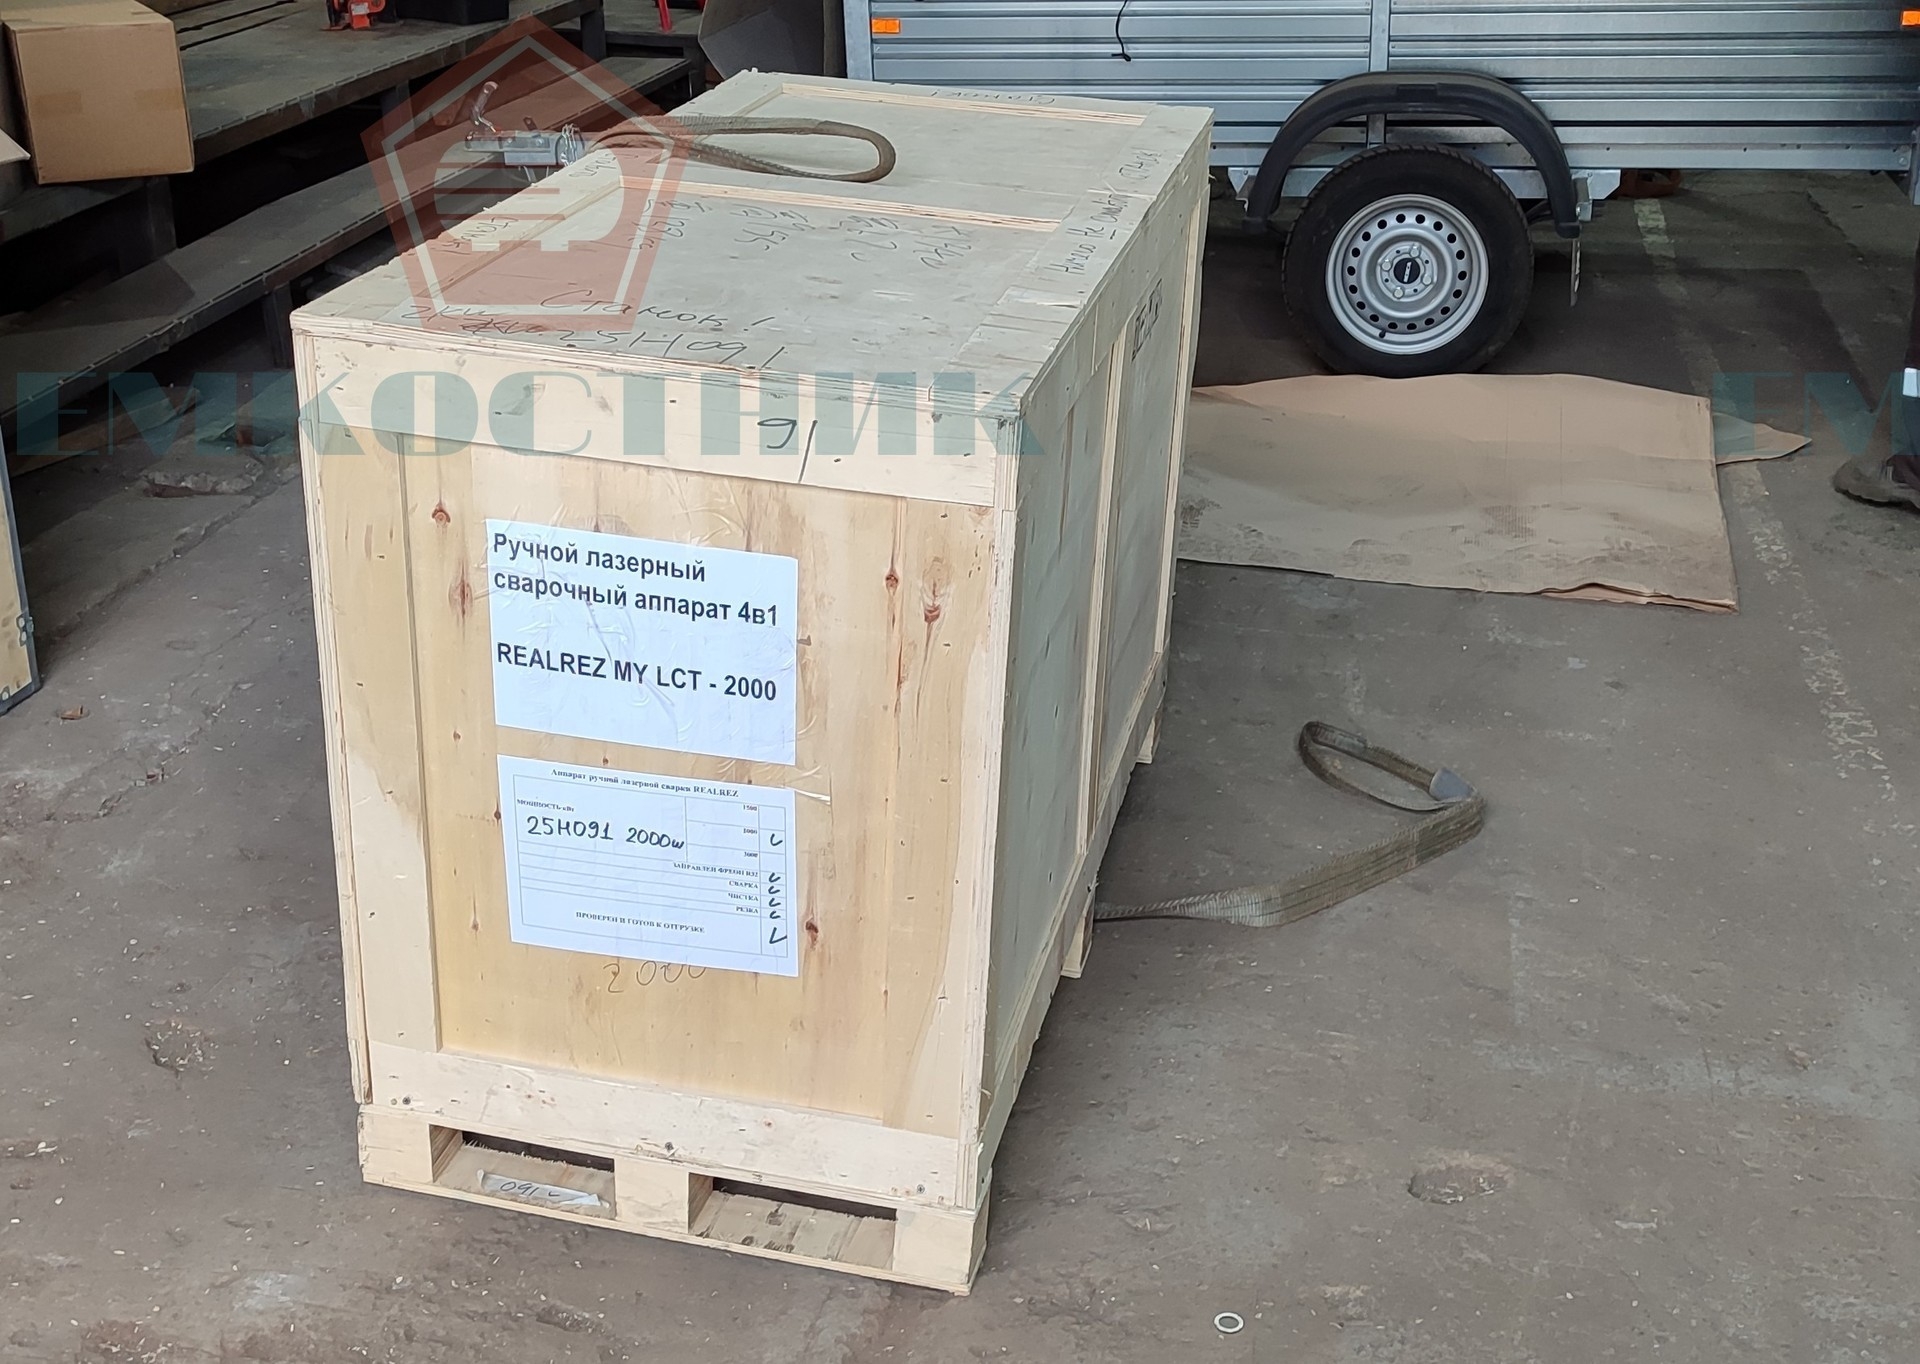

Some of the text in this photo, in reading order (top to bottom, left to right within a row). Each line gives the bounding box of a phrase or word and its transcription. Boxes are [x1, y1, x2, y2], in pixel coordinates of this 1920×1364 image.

[494, 533, 705, 582] Ручной лазерный
[494, 572, 777, 626] сварочный аппарат 4в1
[497, 642, 606, 679] REALREZ
[614, 660, 648, 684] MY
[657, 666, 702, 691] LCT
[724, 675, 777, 701] 2000
[551, 768, 586, 782] Аппарат
[693, 786, 739, 798] REALREZ
[500, 1181, 538, 1197] 091
